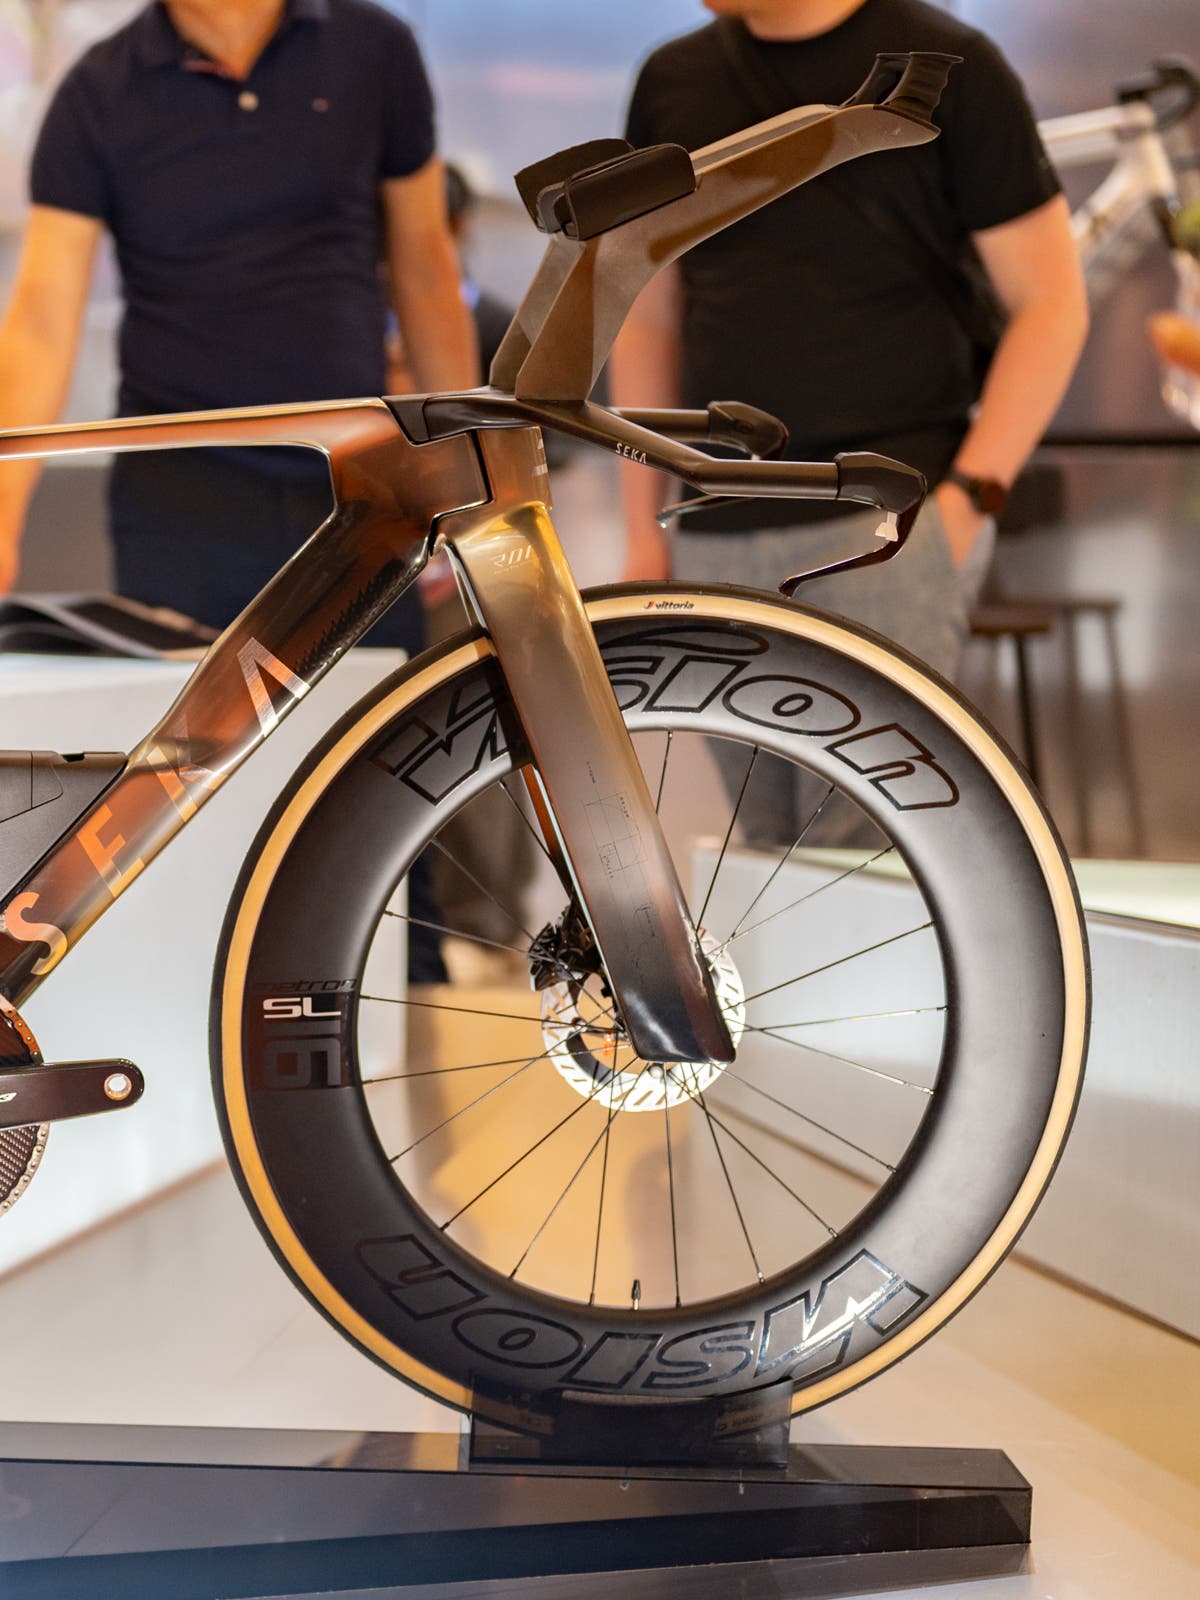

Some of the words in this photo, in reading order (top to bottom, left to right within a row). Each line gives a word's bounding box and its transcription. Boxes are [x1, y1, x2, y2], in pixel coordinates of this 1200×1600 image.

[615, 442, 647, 464] SEKA
[654, 600, 695, 610] vittoria
[4, 637, 311, 976] SEKA
[263, 996, 342, 1019] SL
